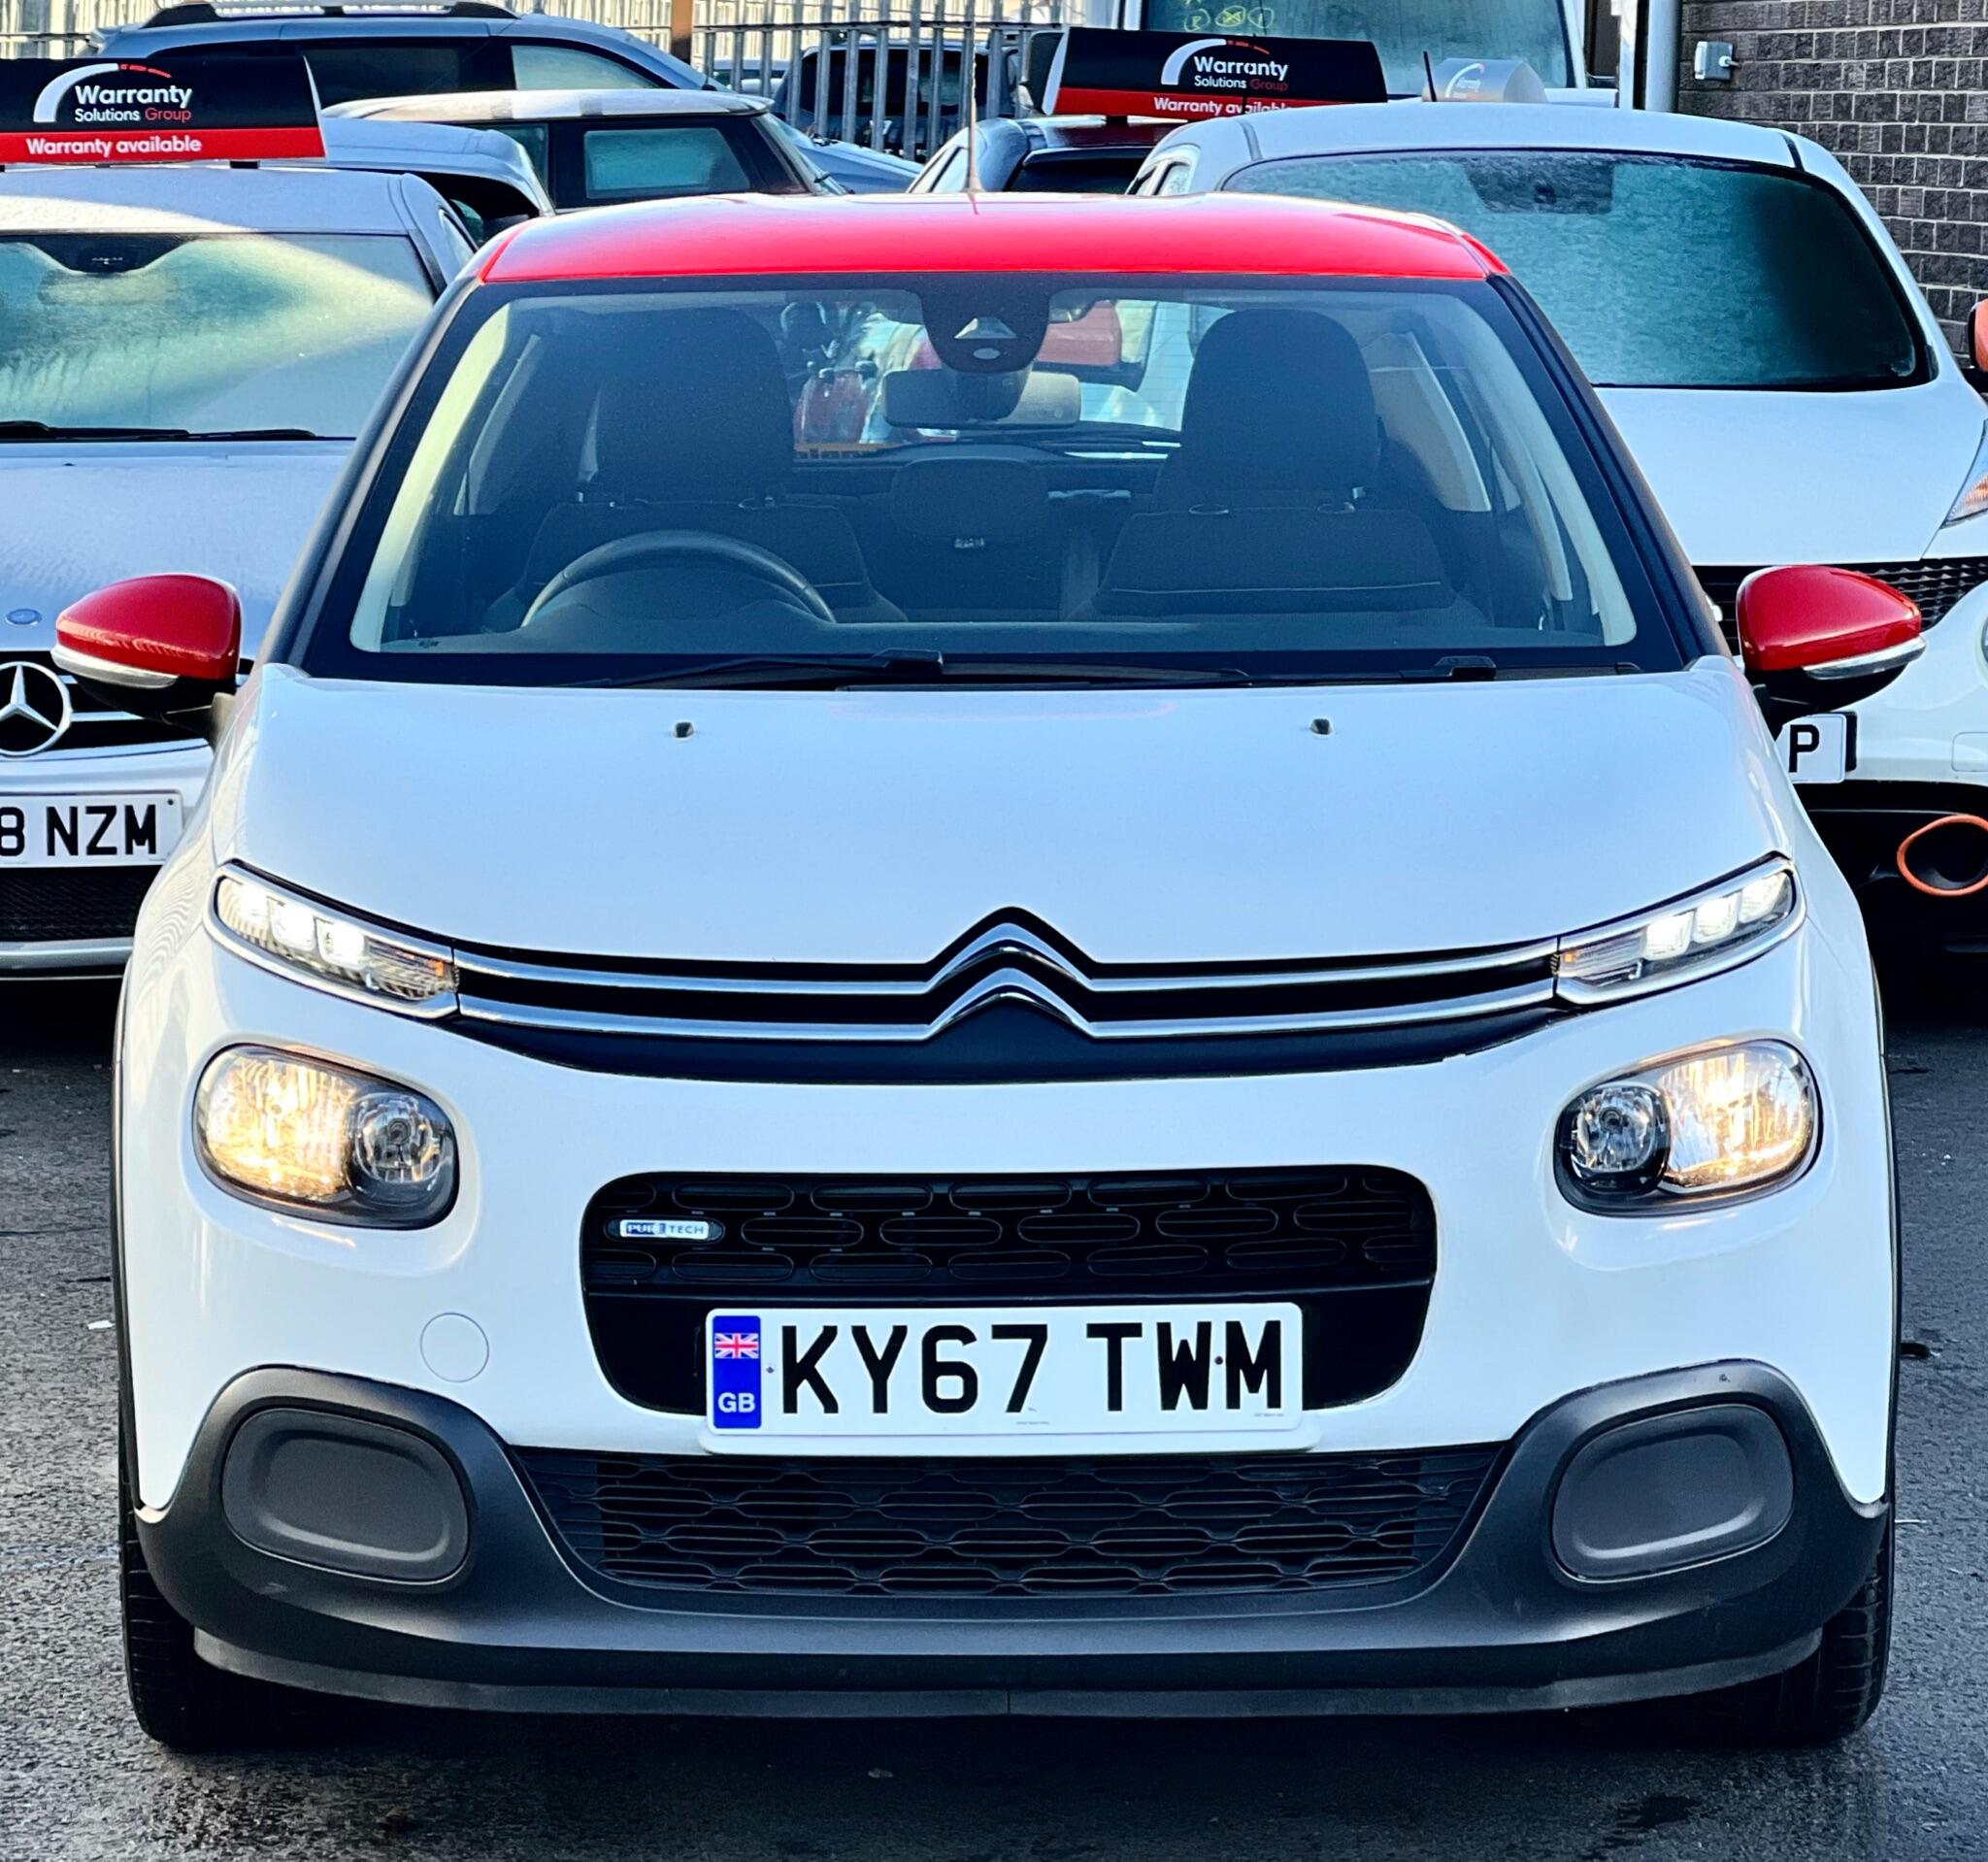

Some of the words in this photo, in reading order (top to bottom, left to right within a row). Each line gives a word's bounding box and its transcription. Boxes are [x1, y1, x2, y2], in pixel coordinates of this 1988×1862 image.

[1193, 56, 1289, 81] Warranty
[1194, 75, 1247, 89] Solutions
[1249, 78, 1289, 93] Group
[75, 84, 192, 108] Warranty
[1153, 96, 1223, 116] Warranty
[1225, 101, 1293, 114] availabl
[74, 108, 141, 122] Solutions
[145, 107, 192, 122] Group
[26, 138, 112, 157] Warranty
[116, 135, 202, 153] available
[47, 804, 156, 856] NZM
[781, 1323, 1048, 1414] KY67
[1085, 1319, 1282, 1412] TWM
[716, 1391, 756, 1413] GB
